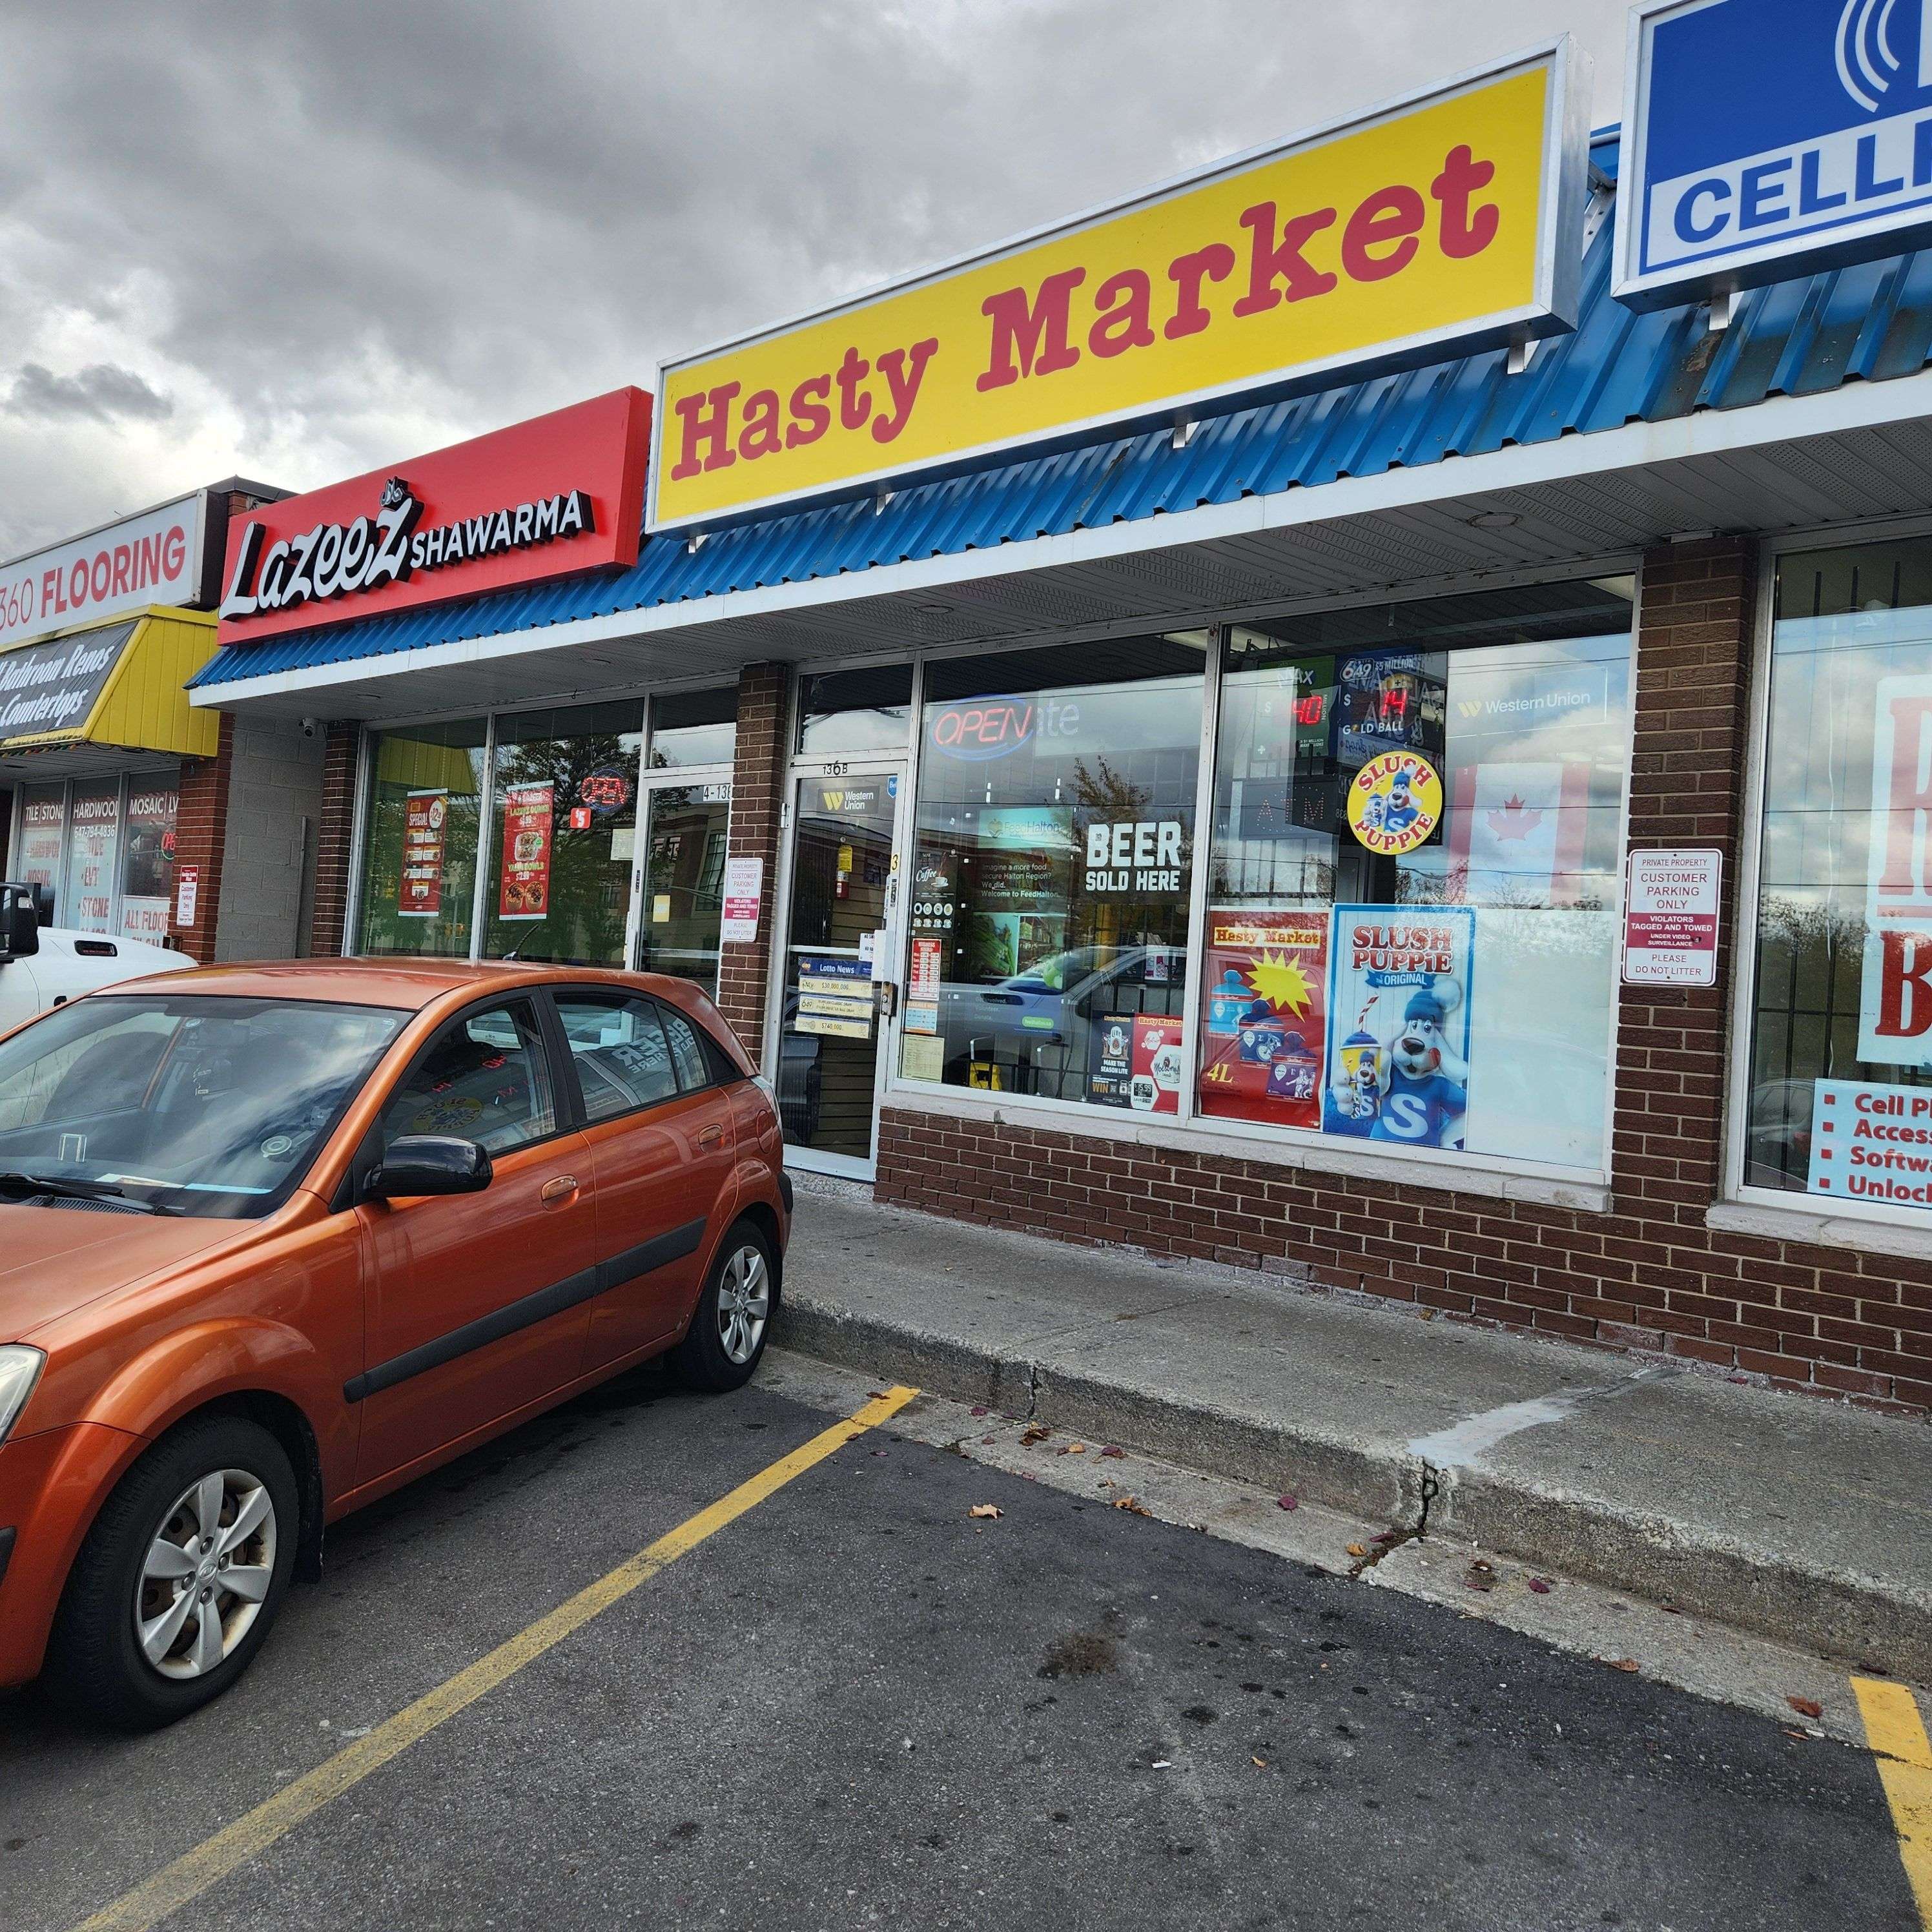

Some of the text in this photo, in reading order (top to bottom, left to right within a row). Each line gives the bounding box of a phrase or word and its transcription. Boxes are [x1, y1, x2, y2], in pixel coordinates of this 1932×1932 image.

[671, 144, 1499, 480] Hasty Market
[412, 489, 583, 569] SHAWARMA
[41, 525, 186, 619] FLOORING
[61, 644, 114, 679] Renos
[1292, 696, 1322, 724] 40
[1485, 691, 1590, 714] Western Union
[934, 706, 1031, 745] OPEN
[1378, 721, 1404, 732] BALL
[845, 791, 874, 801] Western
[129, 797, 164, 814] MOSAIC
[844, 800, 865, 810] Union
[1258, 795, 1324, 824] ATM
[1003, 821, 1060, 832] FeedHalton
[1086, 821, 1181, 867] BEER
[916, 868, 938, 883] Coffee
[1025, 872, 1051, 881] Region?
[1086, 870, 1180, 891] SOLD HERE
[1641, 873, 1707, 883] CUSTOMER
[1647, 887, 1700, 896] PARKING
[1656, 900, 1688, 909] ONLY
[1650, 915, 1694, 923] VIOLATORS
[1215, 929, 1319, 944] Hasty Market
[1352, 925, 1453, 952] SLUSH
[1652, 954, 1687, 963] PLEASE
[820, 963, 836, 972] Lotto
[837, 965, 854, 974] News
[1671, 967, 1701, 976] LITTER
[1384, 974, 1428, 985] ORIGINAL
[1139, 1017, 1183, 1027] Hasty Market
[1207, 1062, 1235, 1083] 4L
[1093, 1082, 1109, 1093] WIN
[1855, 1093, 1932, 1118] Cell P
[1850, 1146, 1932, 1173] Softw
